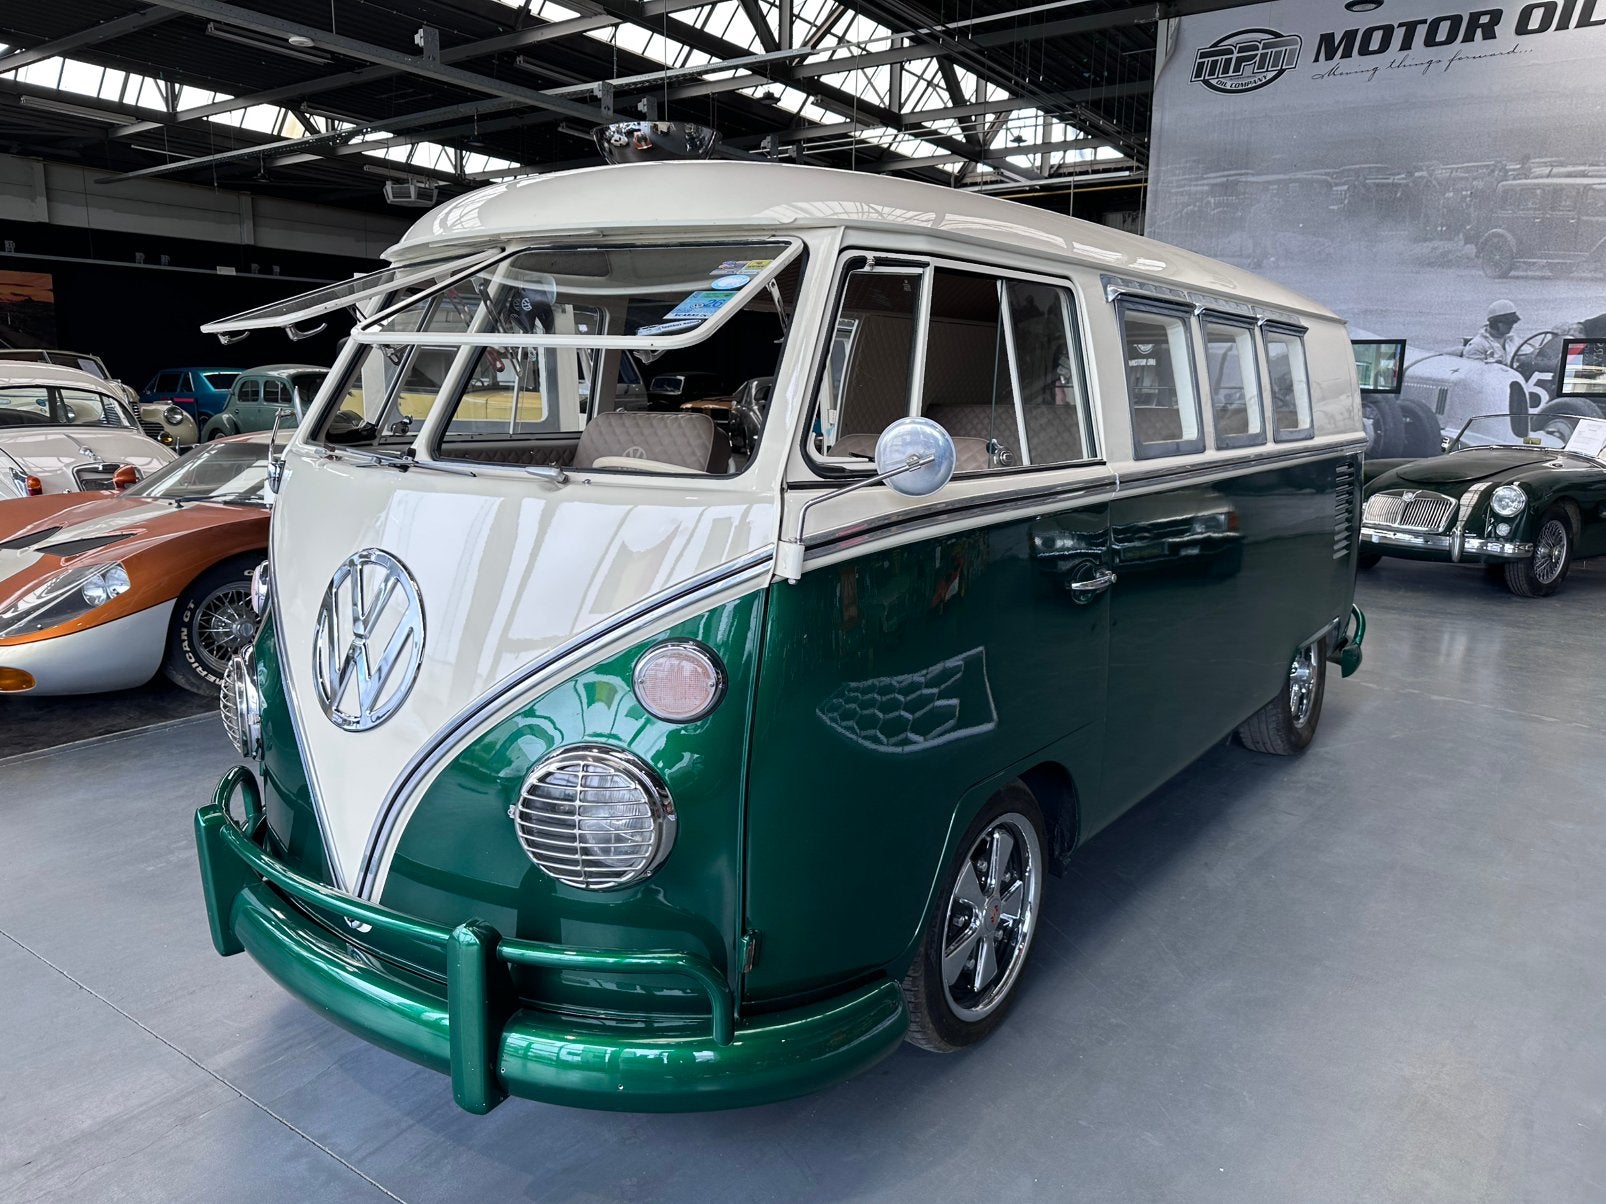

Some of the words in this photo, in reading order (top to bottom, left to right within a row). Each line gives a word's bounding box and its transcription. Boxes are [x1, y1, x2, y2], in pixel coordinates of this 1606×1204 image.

[1312, 8, 1504, 63] MOTOR
[1190, 35, 1303, 82] MPM
[1386, 53, 1443, 75] things
[1216, 79, 1227, 88] OIL
[1229, 74, 1268, 89] COMPANY
[183, 600, 196, 623] GT
